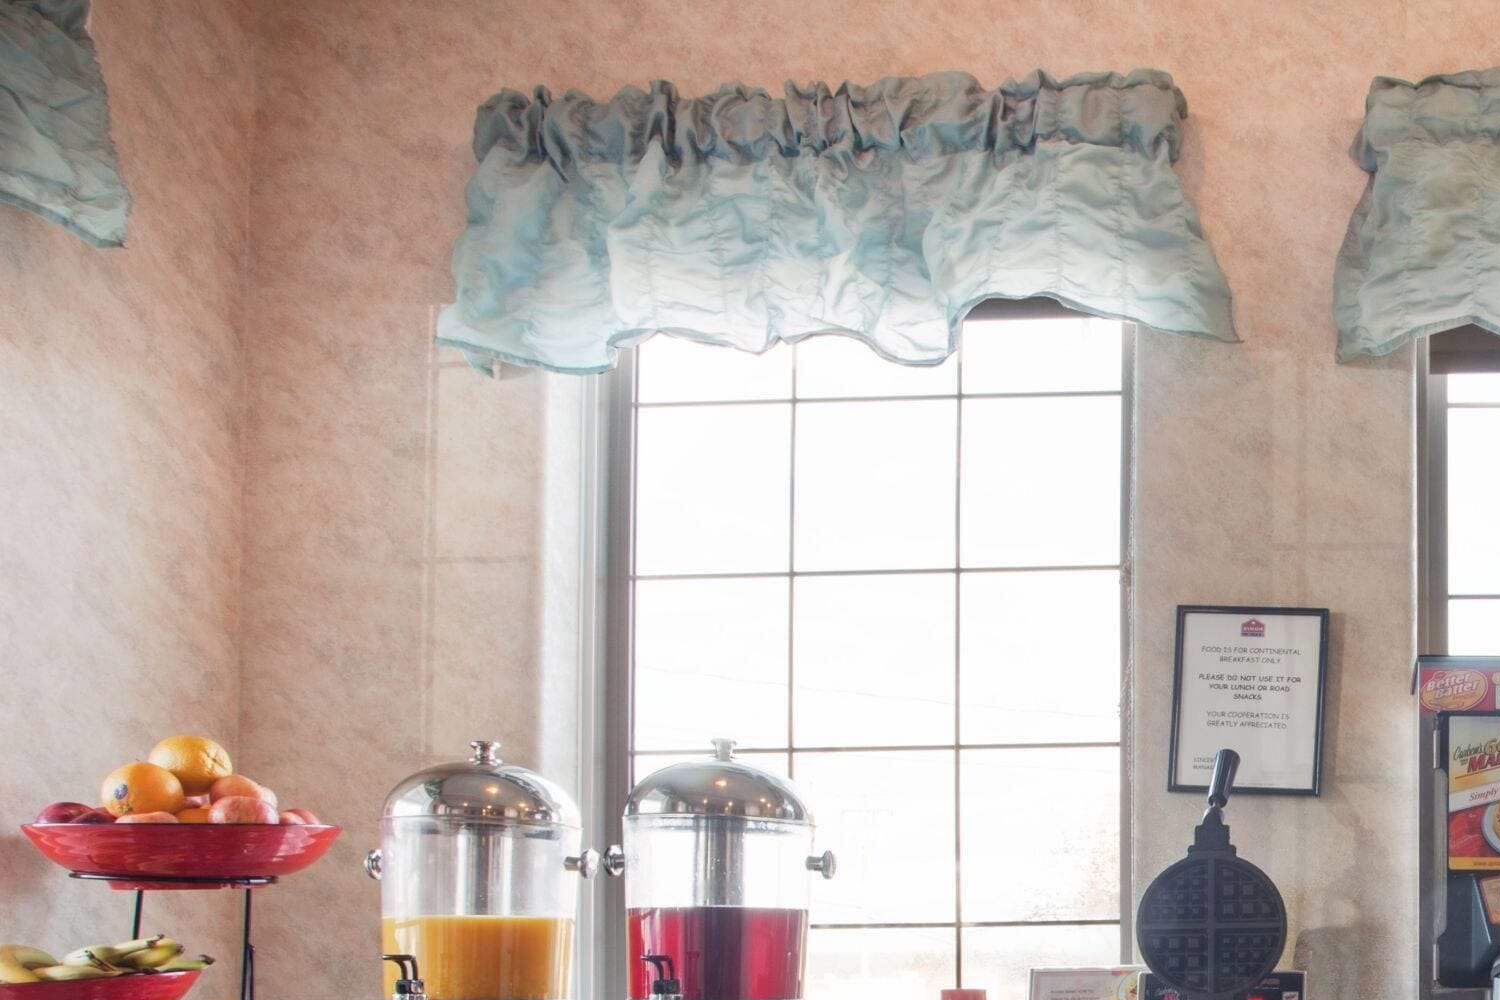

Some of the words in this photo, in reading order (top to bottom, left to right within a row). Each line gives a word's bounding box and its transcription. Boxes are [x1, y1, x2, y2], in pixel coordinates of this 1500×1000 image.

[1249, 647, 1302, 656] CONTINENTAL
[1426, 672, 1472, 691] Better
[1435, 681, 1479, 698] Batter
[1227, 711, 1279, 720] COOPERATION
[1468, 787, 1500, 801] Simply
